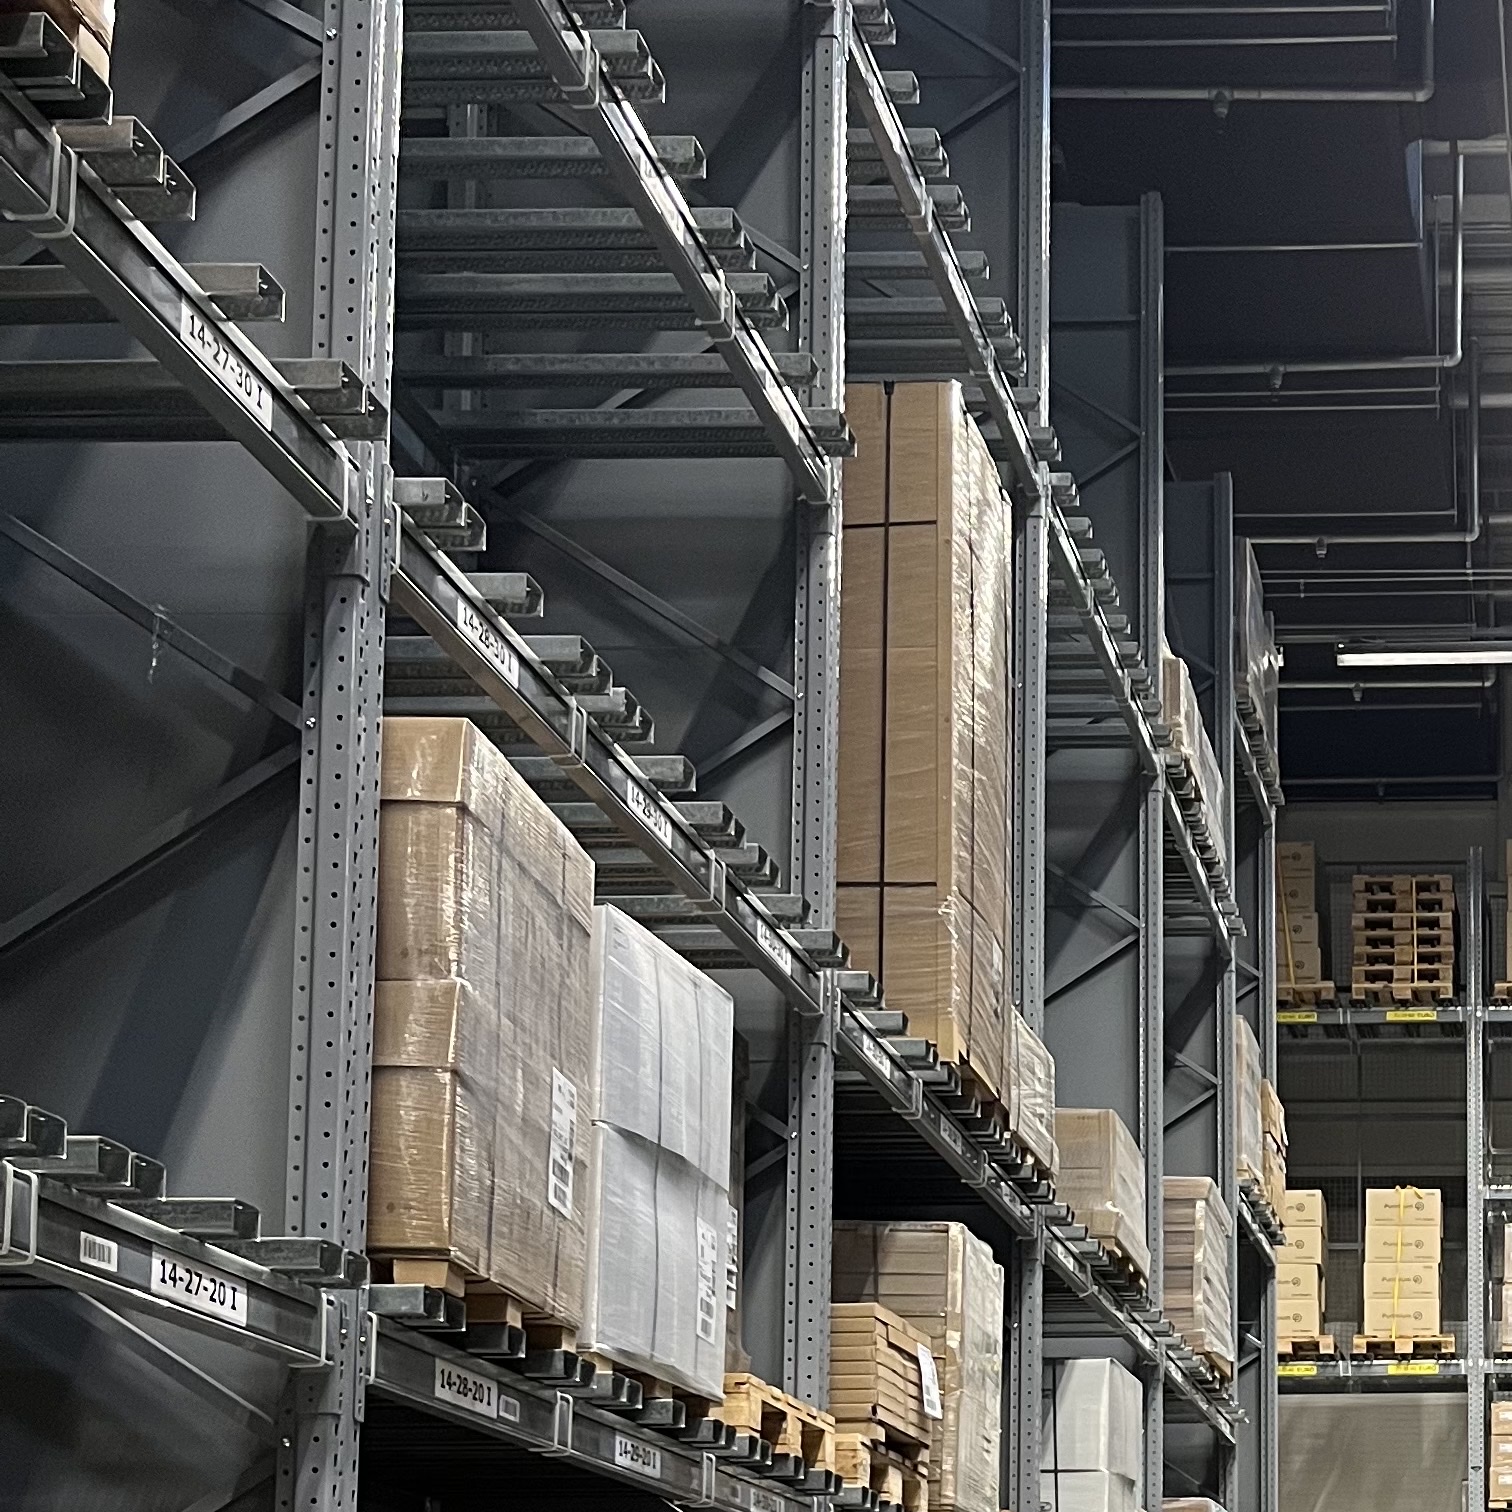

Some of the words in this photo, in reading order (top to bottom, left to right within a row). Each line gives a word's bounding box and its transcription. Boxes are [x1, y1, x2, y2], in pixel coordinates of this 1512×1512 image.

[190, 314, 253, 398] 14-27-30
[160, 1259, 226, 1306] 14-27-20
[440, 1368, 485, 1404] 14-28-20
